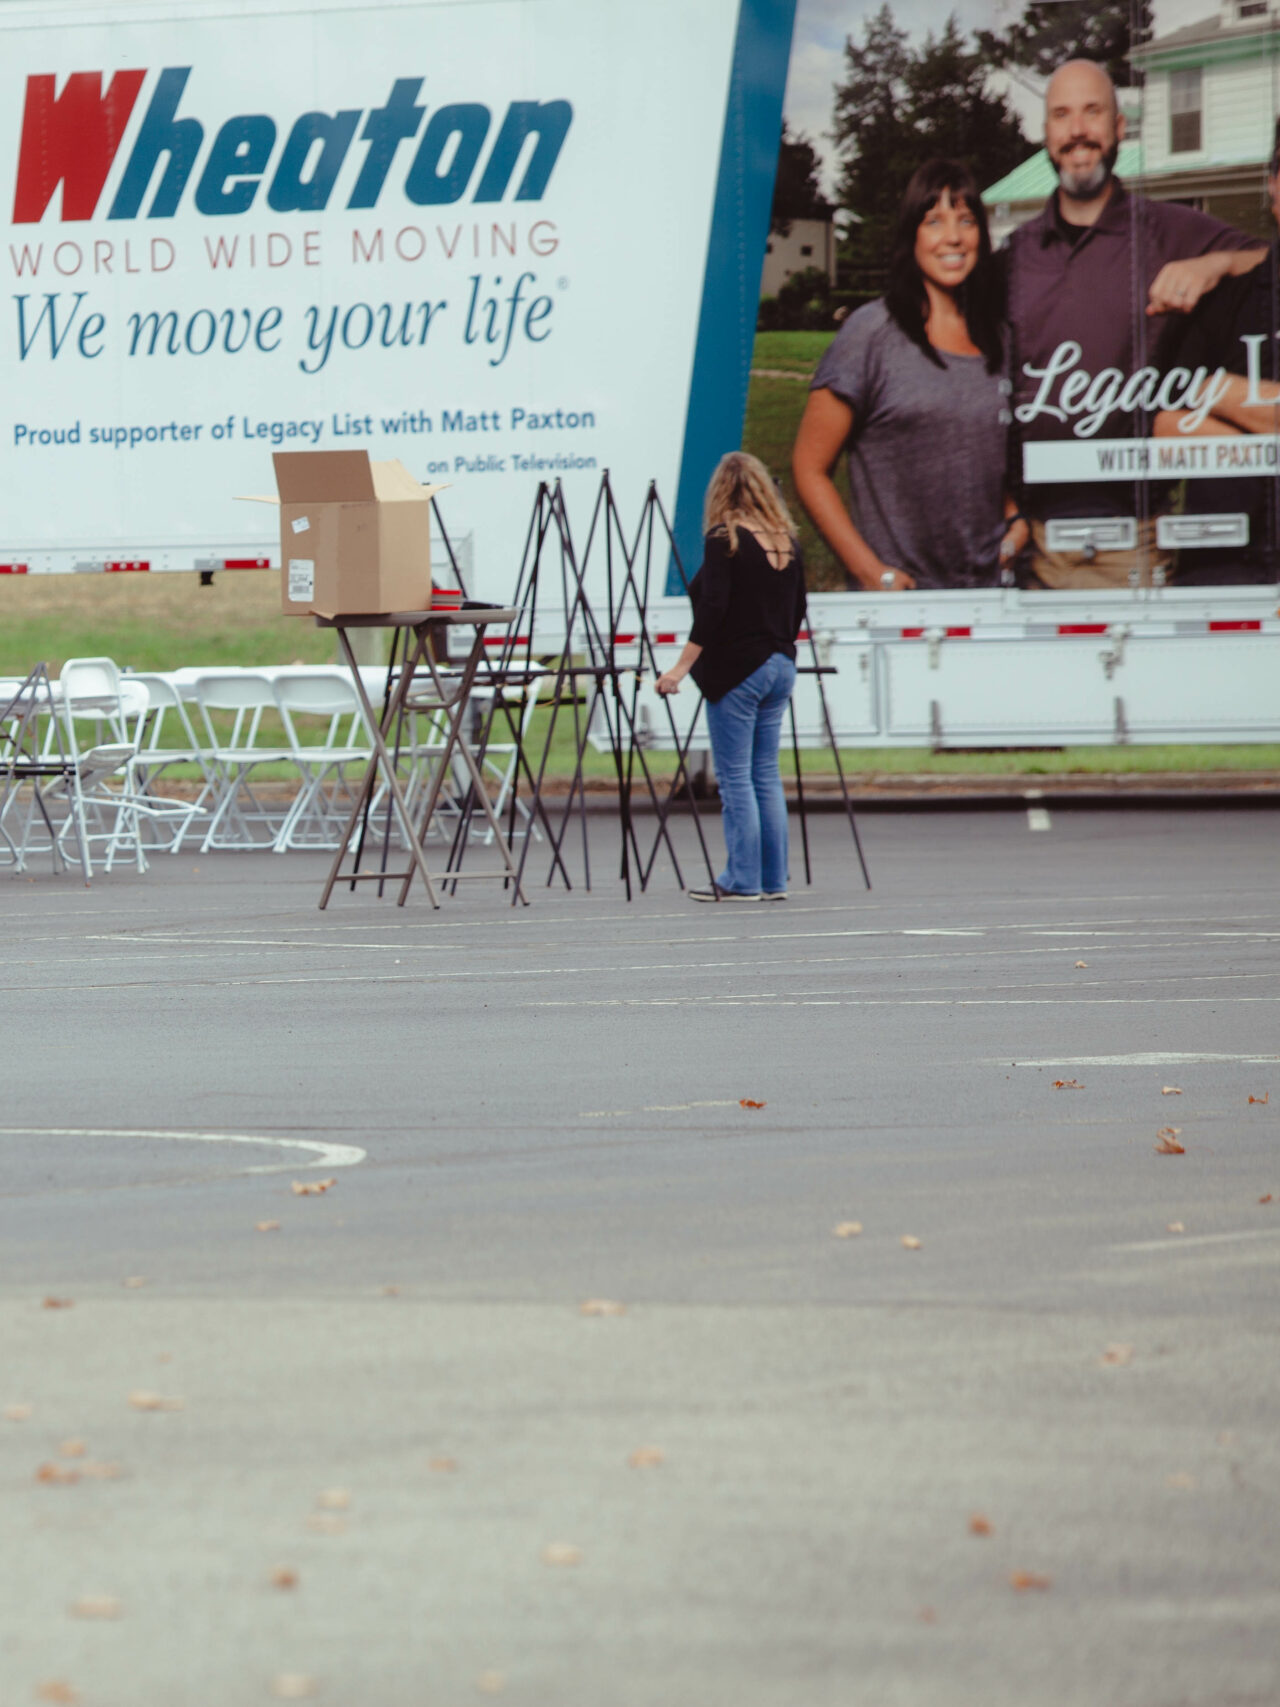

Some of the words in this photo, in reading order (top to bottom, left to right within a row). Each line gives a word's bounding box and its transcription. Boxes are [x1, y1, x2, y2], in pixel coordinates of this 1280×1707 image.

[11, 65, 573, 225] Wheaton
[9, 237, 175, 277] WORLD
[204, 231, 321, 269] WIDE
[352, 220, 560, 263] MOVING
[11, 291, 106, 361] We
[127, 306, 283, 357] move
[298, 300, 447, 374] your
[1015, 340, 1232, 437] Legacy
[1239, 330, 1280, 407] L
[13, 420, 81, 446] Proud
[89, 420, 202, 449] supporter
[211, 415, 236, 440] of
[243, 416, 324, 444] Legacy
[332, 413, 373, 436] List
[381, 410, 433, 434] with
[441, 410, 501, 432] Matt
[511, 408, 596, 430] Paxton
[427, 459, 449, 473] on
[454, 455, 505, 473] Public
[511, 453, 597, 471] Television
[1097, 446, 1150, 472] WITH
[1157, 444, 1209, 471] MATT
